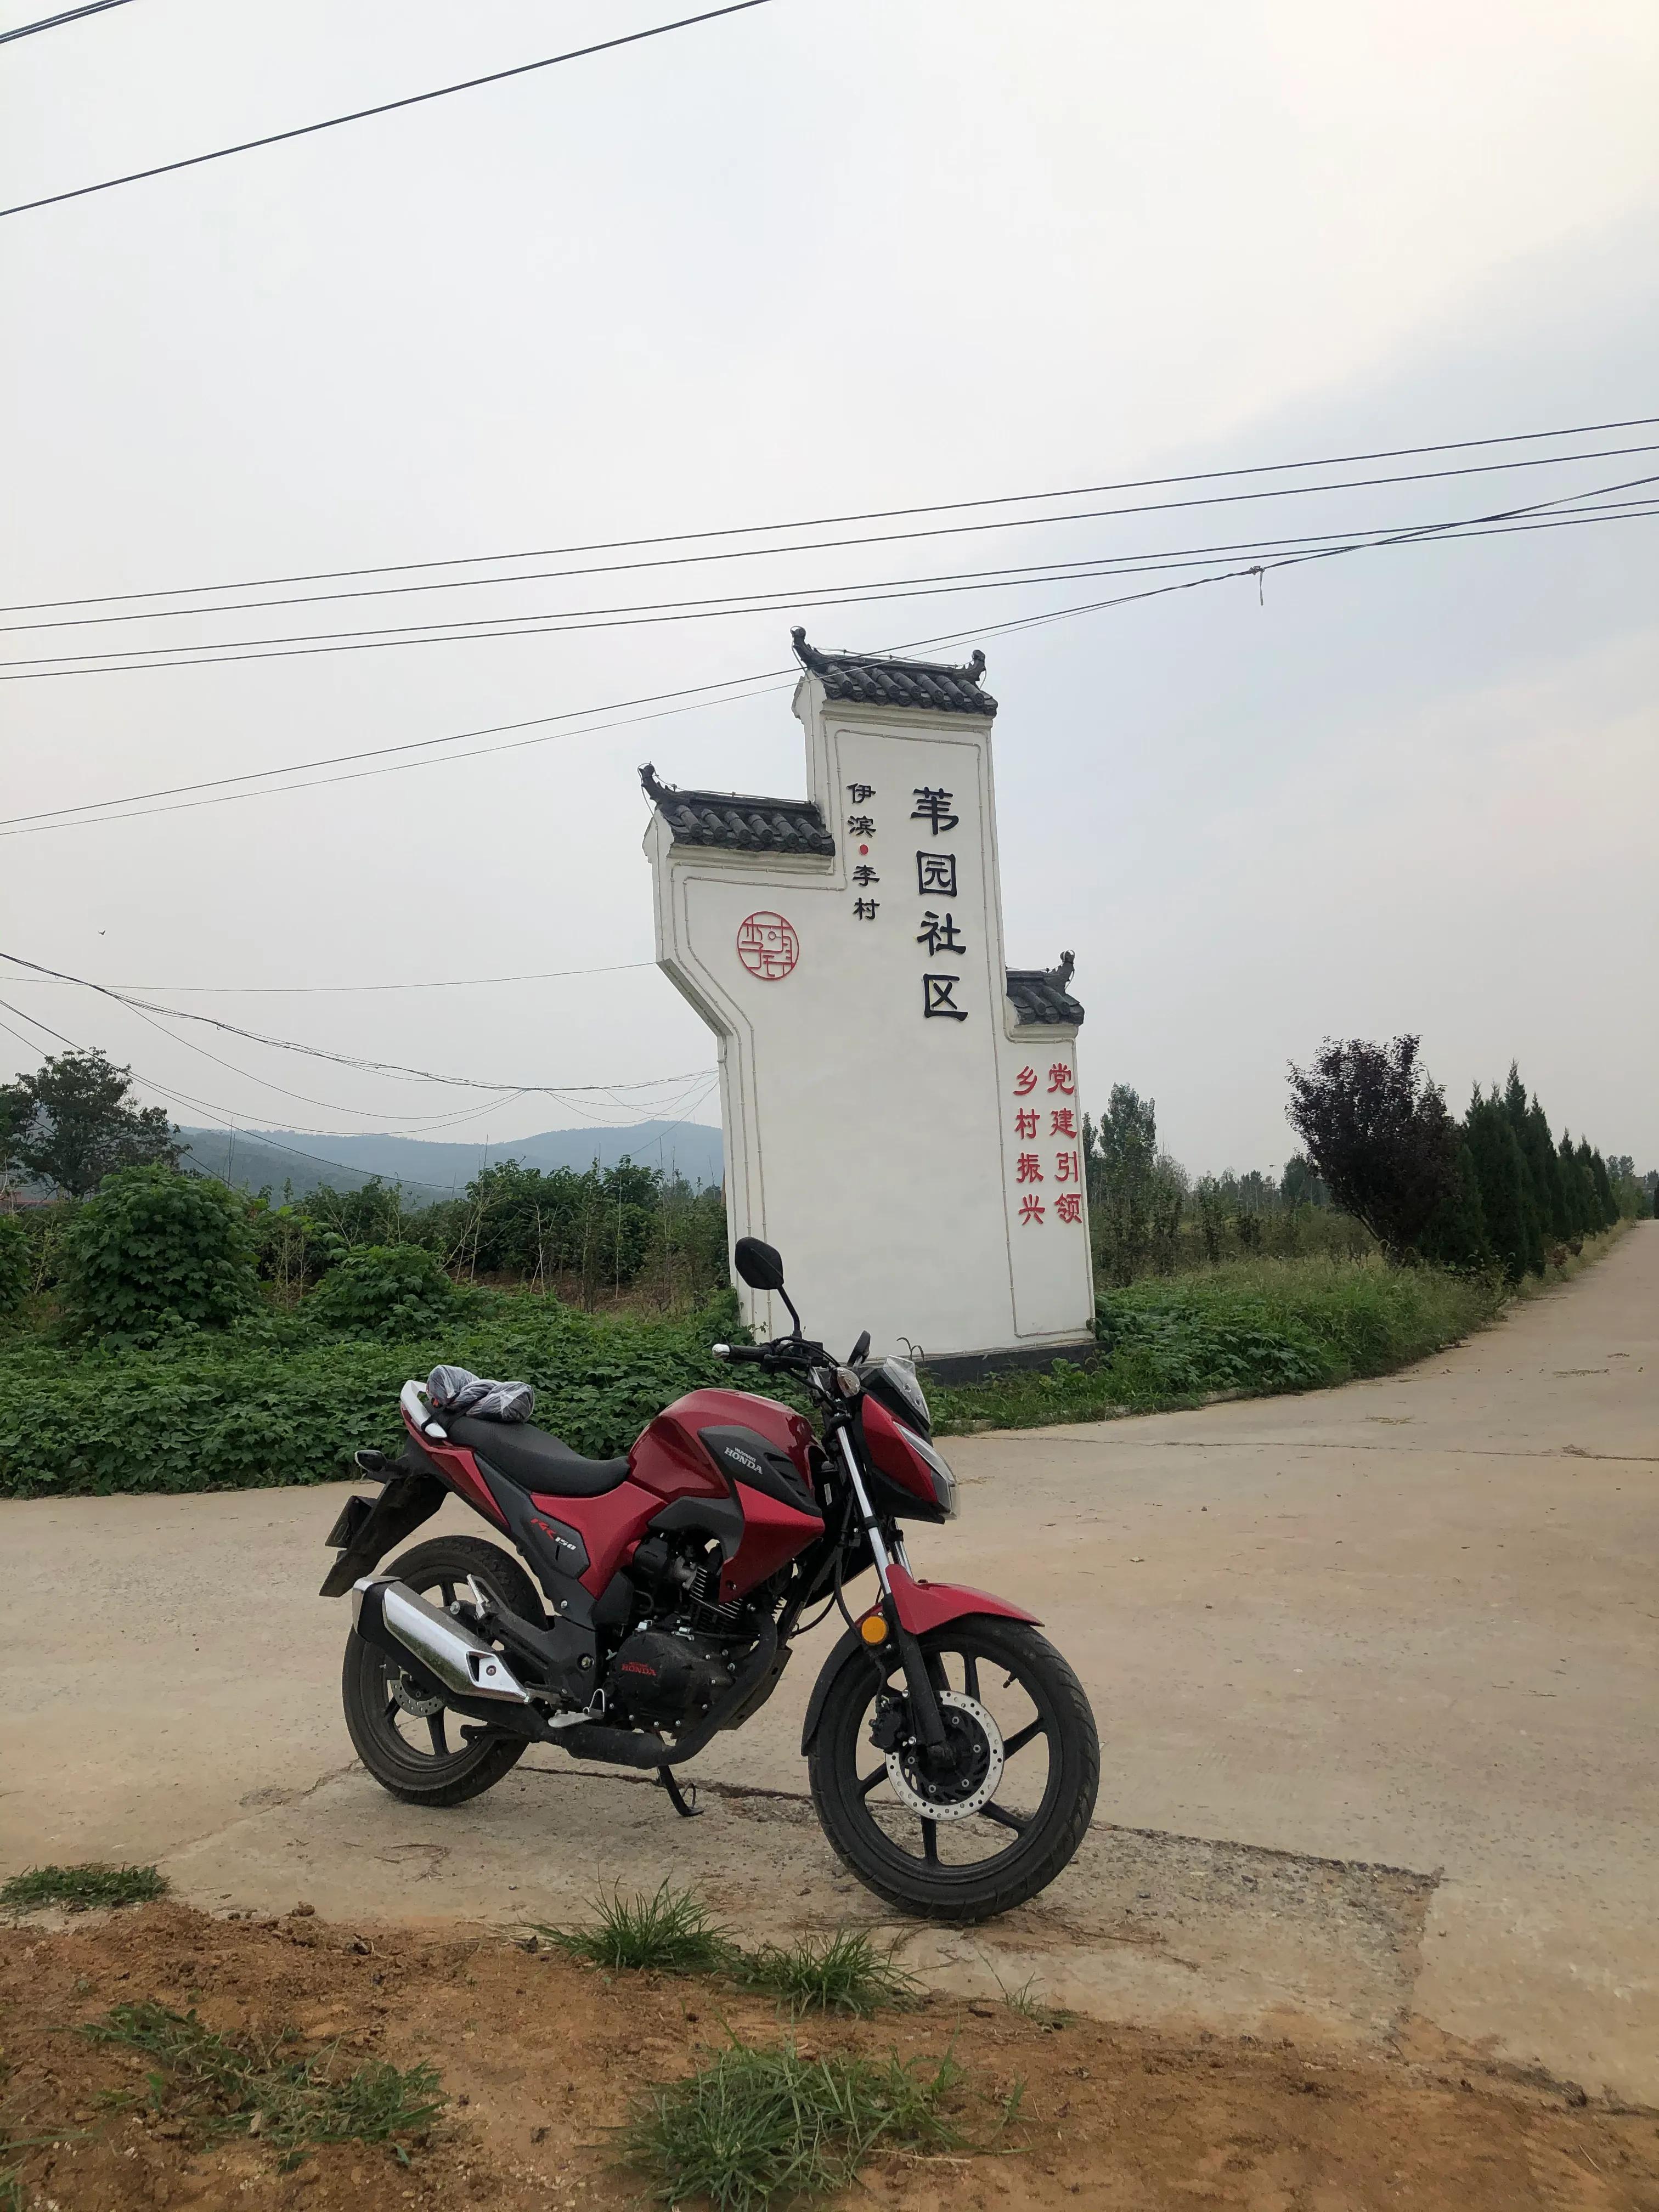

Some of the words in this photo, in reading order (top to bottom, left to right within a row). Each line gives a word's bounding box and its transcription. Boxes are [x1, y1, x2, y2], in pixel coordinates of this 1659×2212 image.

[910, 786, 969, 1022] 苇园社区
[1013, 1065, 1045, 1226] 乡村振兴
[1047, 1062, 1082, 1224] 党建引领
[724, 1447, 763, 1475] HONDA
[622, 1663, 657, 1676] HONDA
